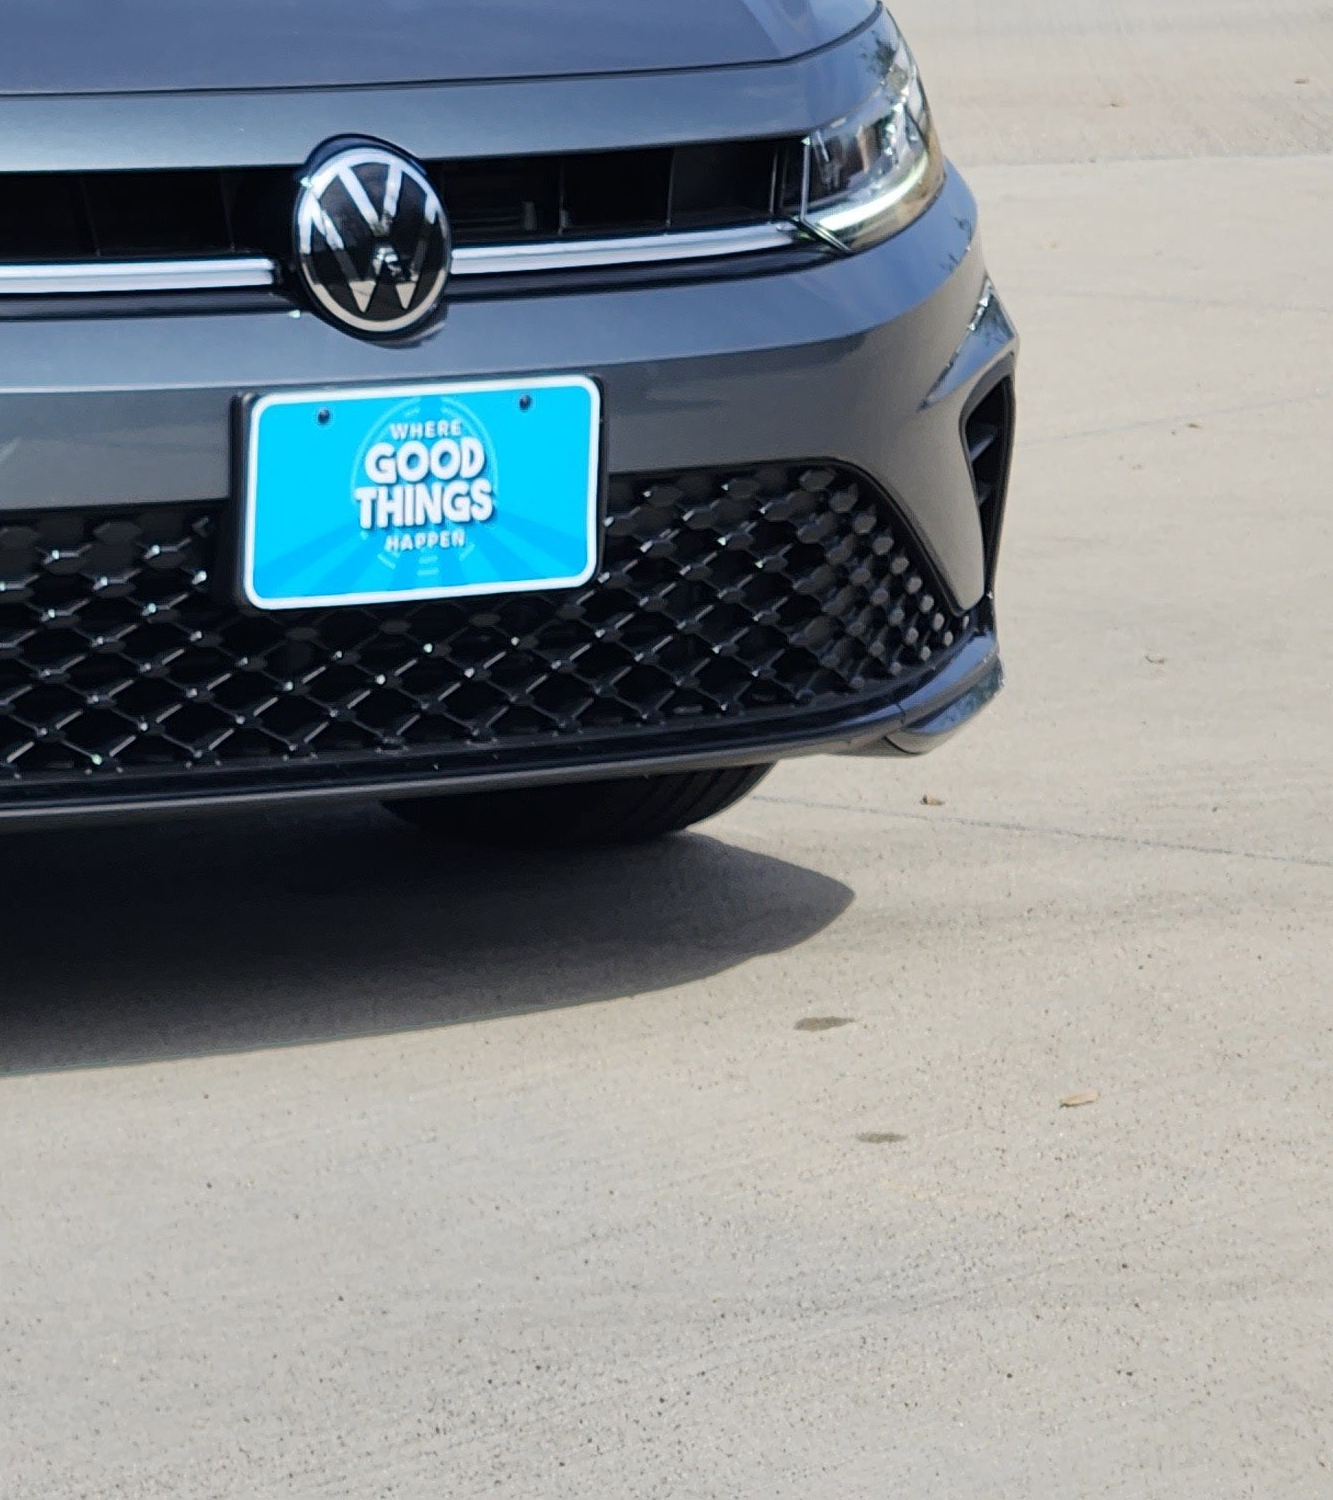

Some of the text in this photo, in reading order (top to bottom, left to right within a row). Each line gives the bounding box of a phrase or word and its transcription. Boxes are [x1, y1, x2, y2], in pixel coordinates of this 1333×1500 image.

[390, 419, 462, 440] WHERE
[365, 436, 484, 484] GOOD
[354, 478, 493, 529] THINGS
[384, 528, 465, 550] HAPPEN
